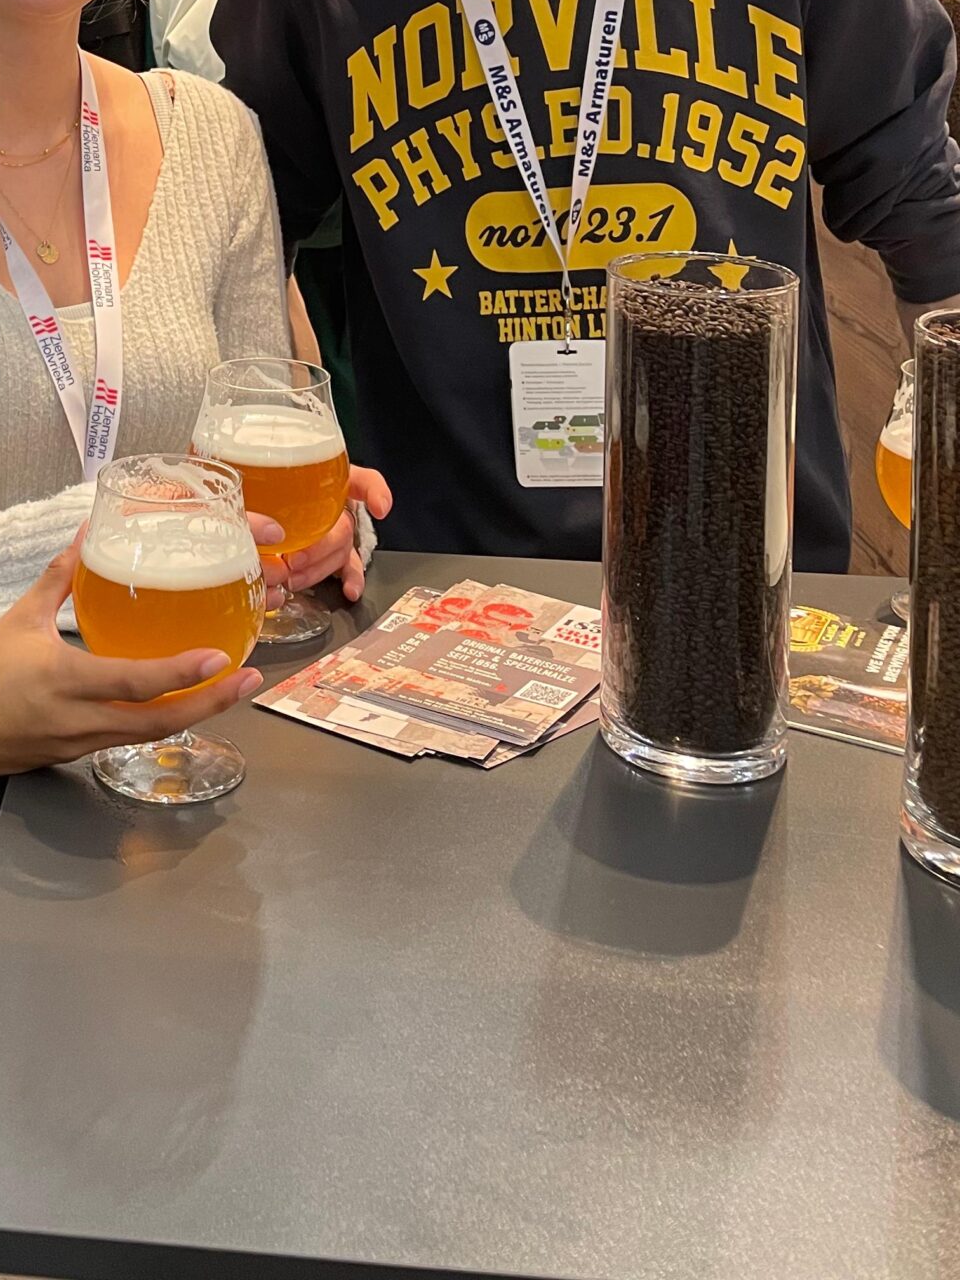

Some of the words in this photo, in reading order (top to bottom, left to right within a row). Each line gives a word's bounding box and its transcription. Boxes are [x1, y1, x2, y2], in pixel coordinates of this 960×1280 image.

[586, 10, 618, 125] Armaturen
[83, 124, 92, 172] Holvrieka
[90, 126, 101, 172] Ziemann
[488, 64, 517, 113] M&S
[506, 118, 551, 228] Armaturen
[578, 130, 597, 178] M&S
[101, 262, 114, 308] Ziemann
[478, 288, 564, 316] BATTER
[498, 314, 581, 343] HINTON
[39, 337, 66, 391] Holvrieka
[50, 333, 75, 387] Ziemann
[87, 404, 104, 458] Holvrieka
[97, 406, 116, 460] Ziemann
[563, 619, 602, 634] 185
[446, 650, 471, 662] SEIT
[454, 644, 489, 658] BASIS-
[491, 655, 501, 663] &
[503, 659, 577, 684] SPEZIALMALZE
[461, 638, 506, 657] ORIGINAL
[509, 652, 572, 674] BAYERISCHE
